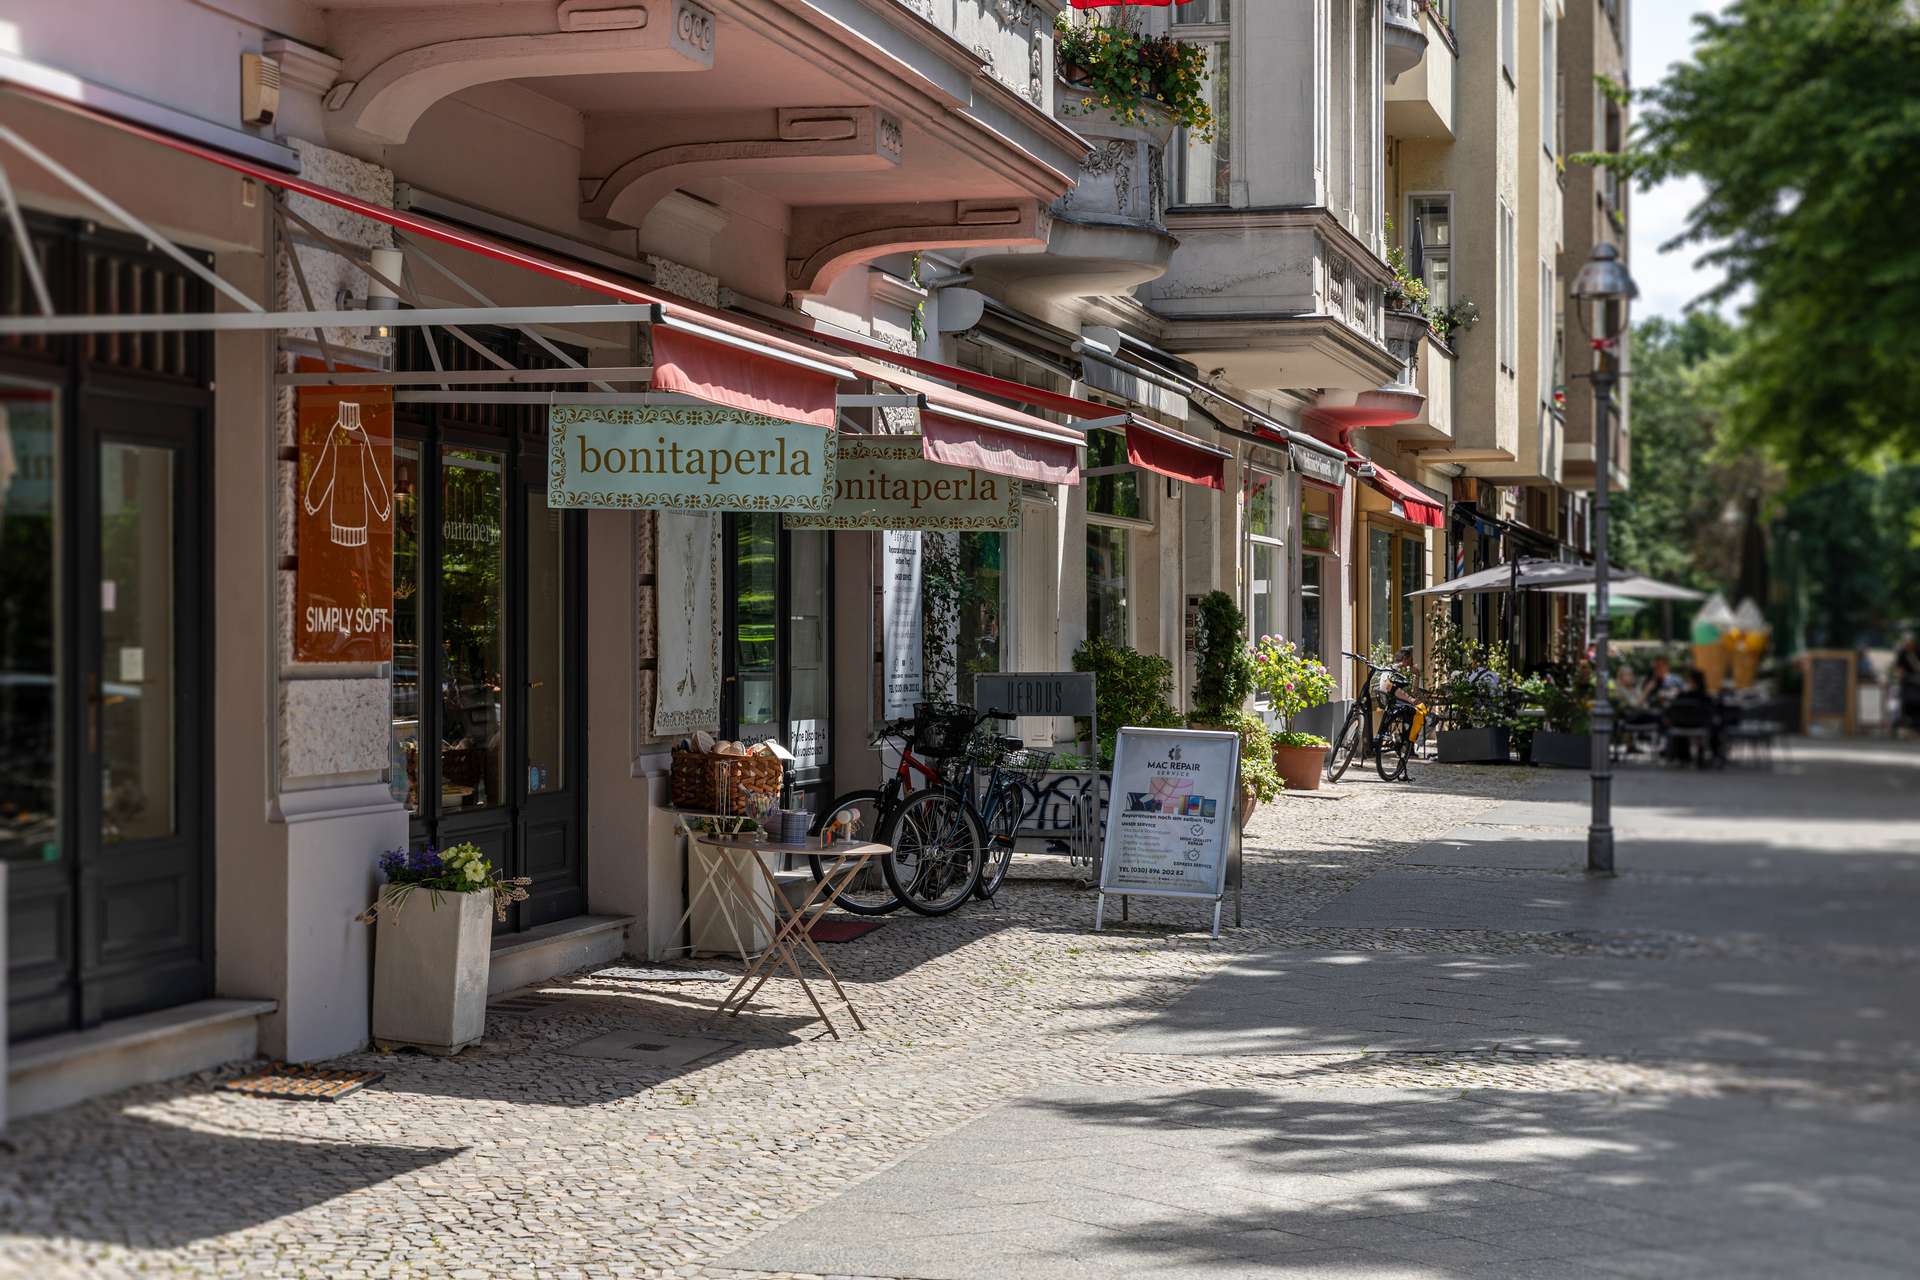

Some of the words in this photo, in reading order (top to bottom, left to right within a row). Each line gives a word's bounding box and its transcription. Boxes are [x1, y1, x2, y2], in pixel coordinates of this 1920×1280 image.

[577, 434, 811, 484] bonitaperla
[834, 469, 998, 507] onitaperla
[443, 514, 501, 549] onitaperla
[305, 607, 353, 634] SIMPLY
[355, 607, 388, 633] SOFT
[1147, 761, 1168, 769] MAC
[1170, 762, 1201, 771] REPAIR
[1203, 817, 1216, 825] Tag!
